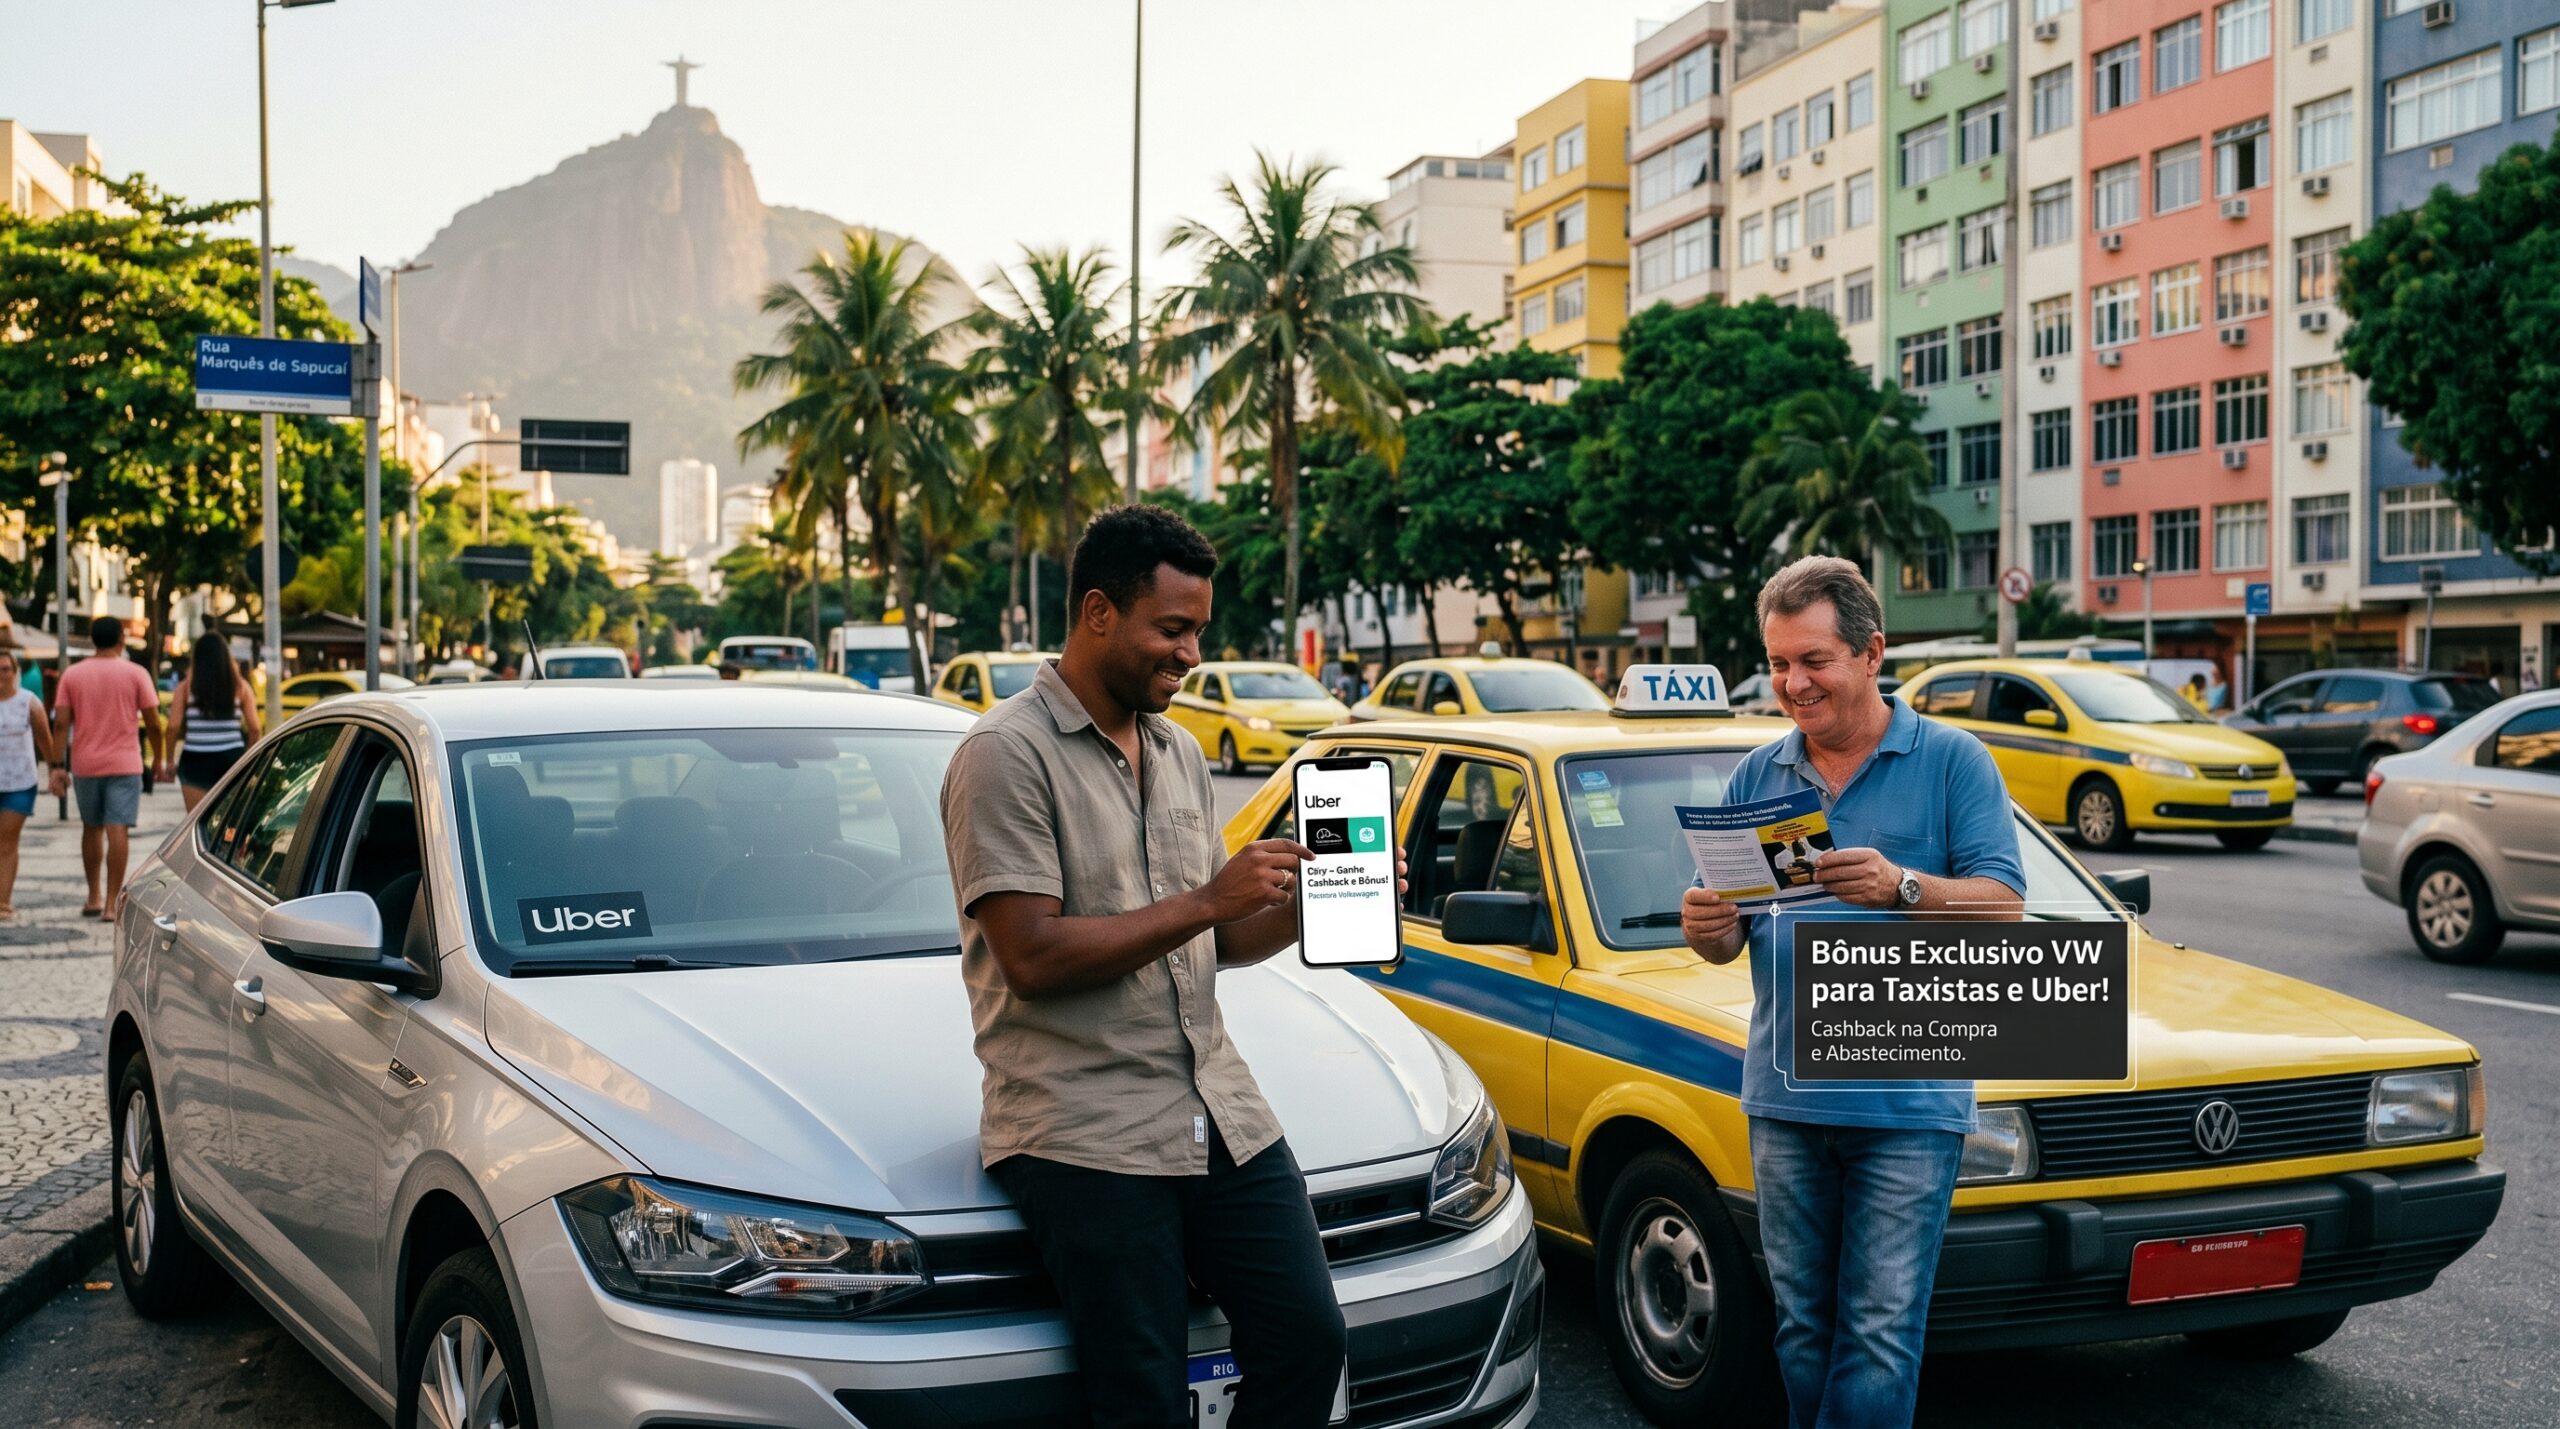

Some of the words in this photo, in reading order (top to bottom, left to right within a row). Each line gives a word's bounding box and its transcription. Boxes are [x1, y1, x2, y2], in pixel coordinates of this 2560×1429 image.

[201, 340, 230, 353] Rua
[201, 355, 264, 372] Marquês
[269, 359, 287, 371] de
[291, 360, 348, 376] Sapucaí
[1643, 669, 1716, 701] TÁXI
[1305, 795, 1341, 808] Uber
[1336, 865, 1364, 875] Ganhe
[1307, 877, 1349, 887] Cashback
[1358, 875, 1389, 885] Bônus!
[531, 907, 636, 933] Uber
[1213, 1363, 1234, 1377] RIO
